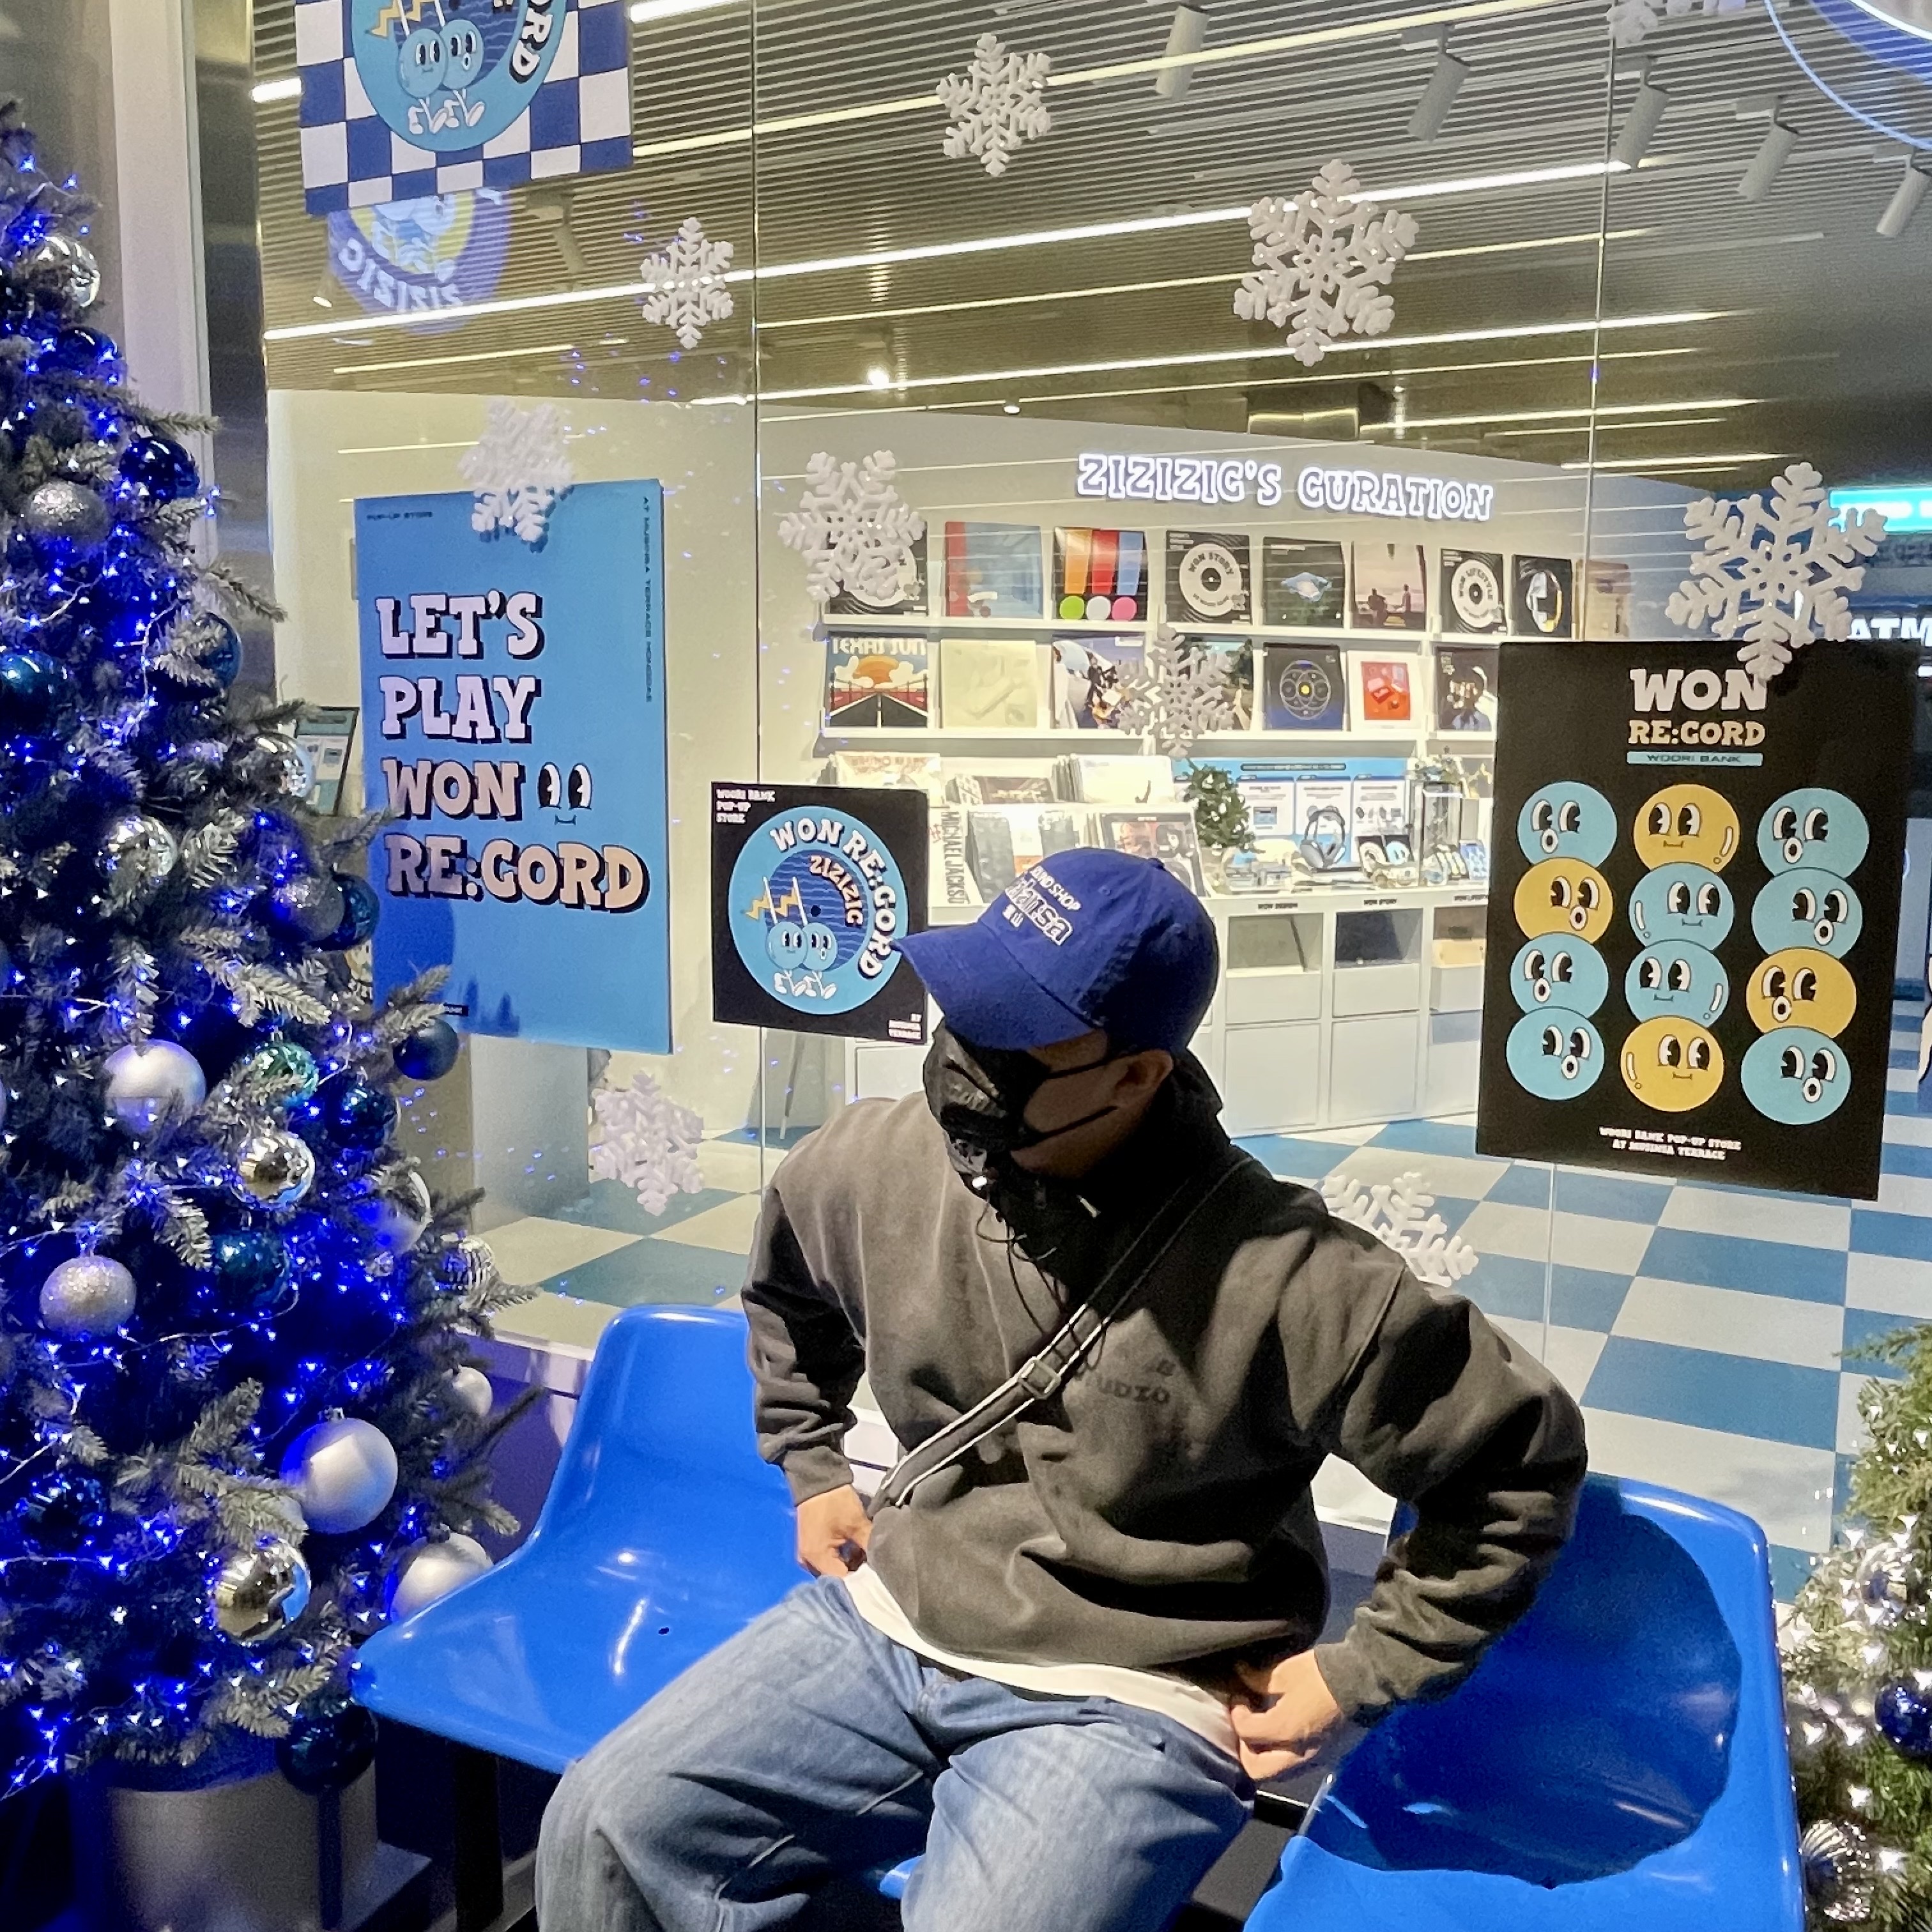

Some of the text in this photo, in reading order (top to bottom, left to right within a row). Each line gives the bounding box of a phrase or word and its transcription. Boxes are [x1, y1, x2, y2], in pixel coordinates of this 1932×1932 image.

[1298, 466, 1494, 521] CURATION
[376, 588, 545, 659] LET'S
[1848, 617, 1932, 646] ATM
[379, 674, 542, 744] PLAY
[1629, 668, 1768, 712] WON
[1628, 720, 1767, 747] RE:CORD
[1699, 755, 1741, 763] BANK
[381, 758, 526, 821] WON
[770, 817, 845, 853] WON
[384, 832, 650, 914] RE:CORD
